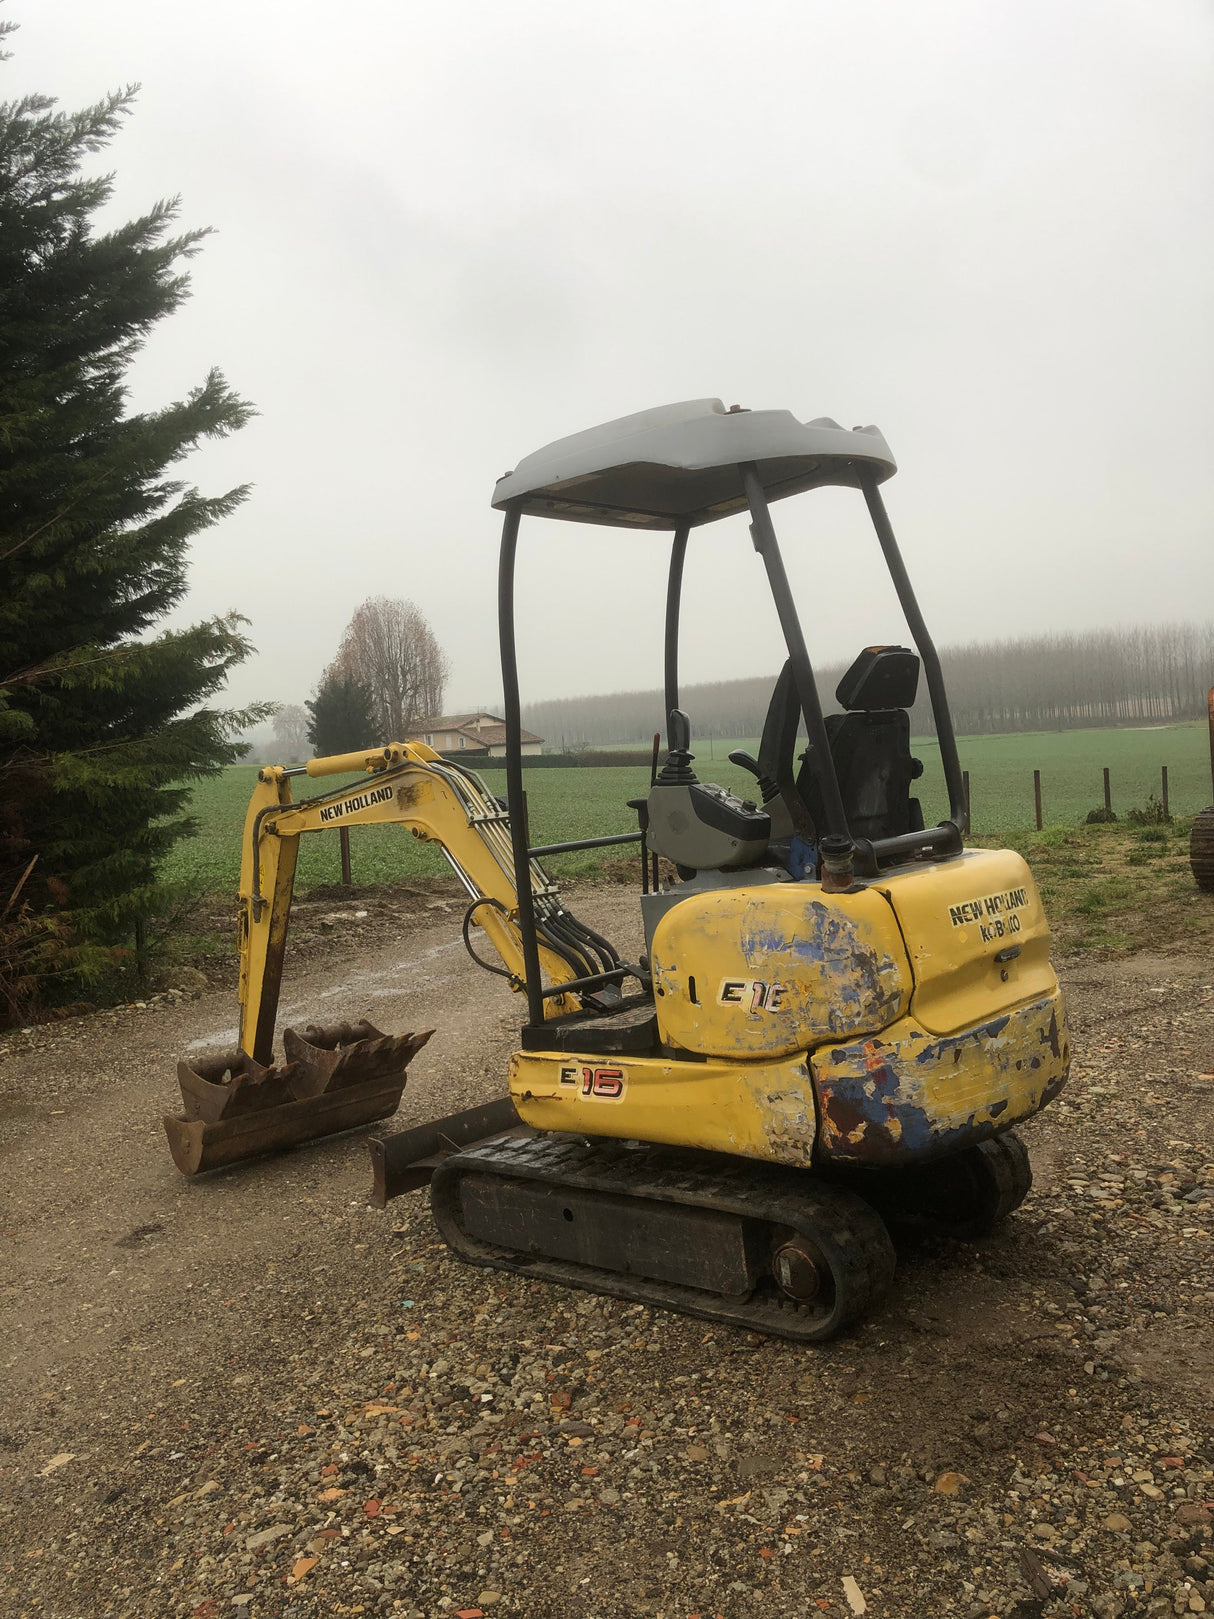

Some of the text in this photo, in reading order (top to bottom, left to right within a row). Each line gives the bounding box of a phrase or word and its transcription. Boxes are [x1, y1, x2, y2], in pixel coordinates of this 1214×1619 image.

[320, 786, 393, 822] NEW HOLLAND
[949, 901, 984, 926] NEW
